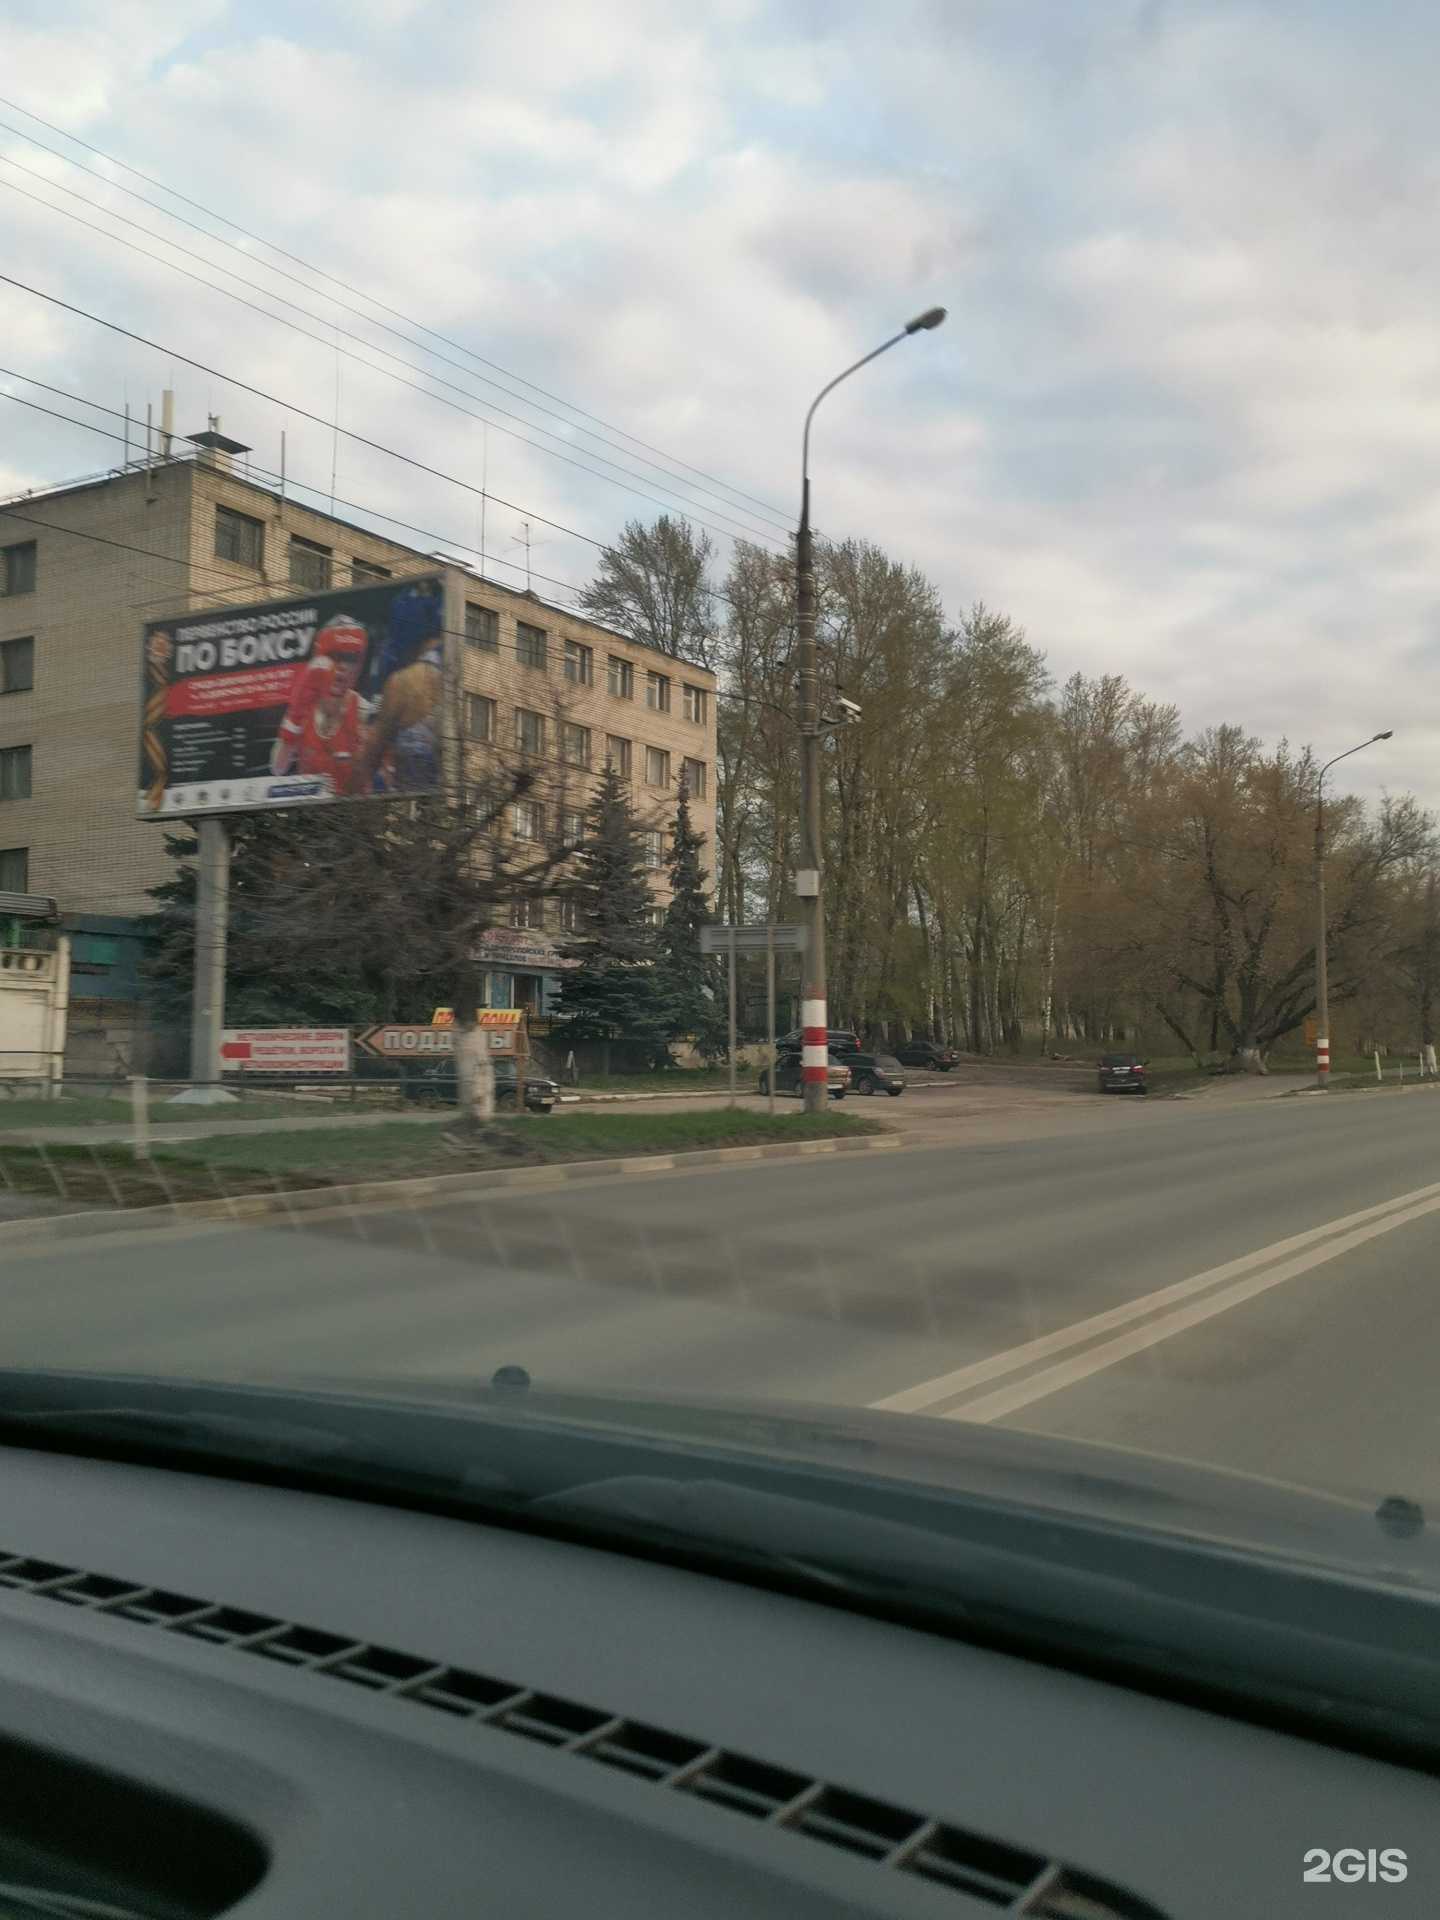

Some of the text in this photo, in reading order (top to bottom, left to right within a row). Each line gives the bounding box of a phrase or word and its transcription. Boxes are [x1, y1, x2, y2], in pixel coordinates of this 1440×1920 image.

[175, 627, 316, 673] ПО БОКСУ
[384, 1030, 513, 1053] ПОДДЫ
